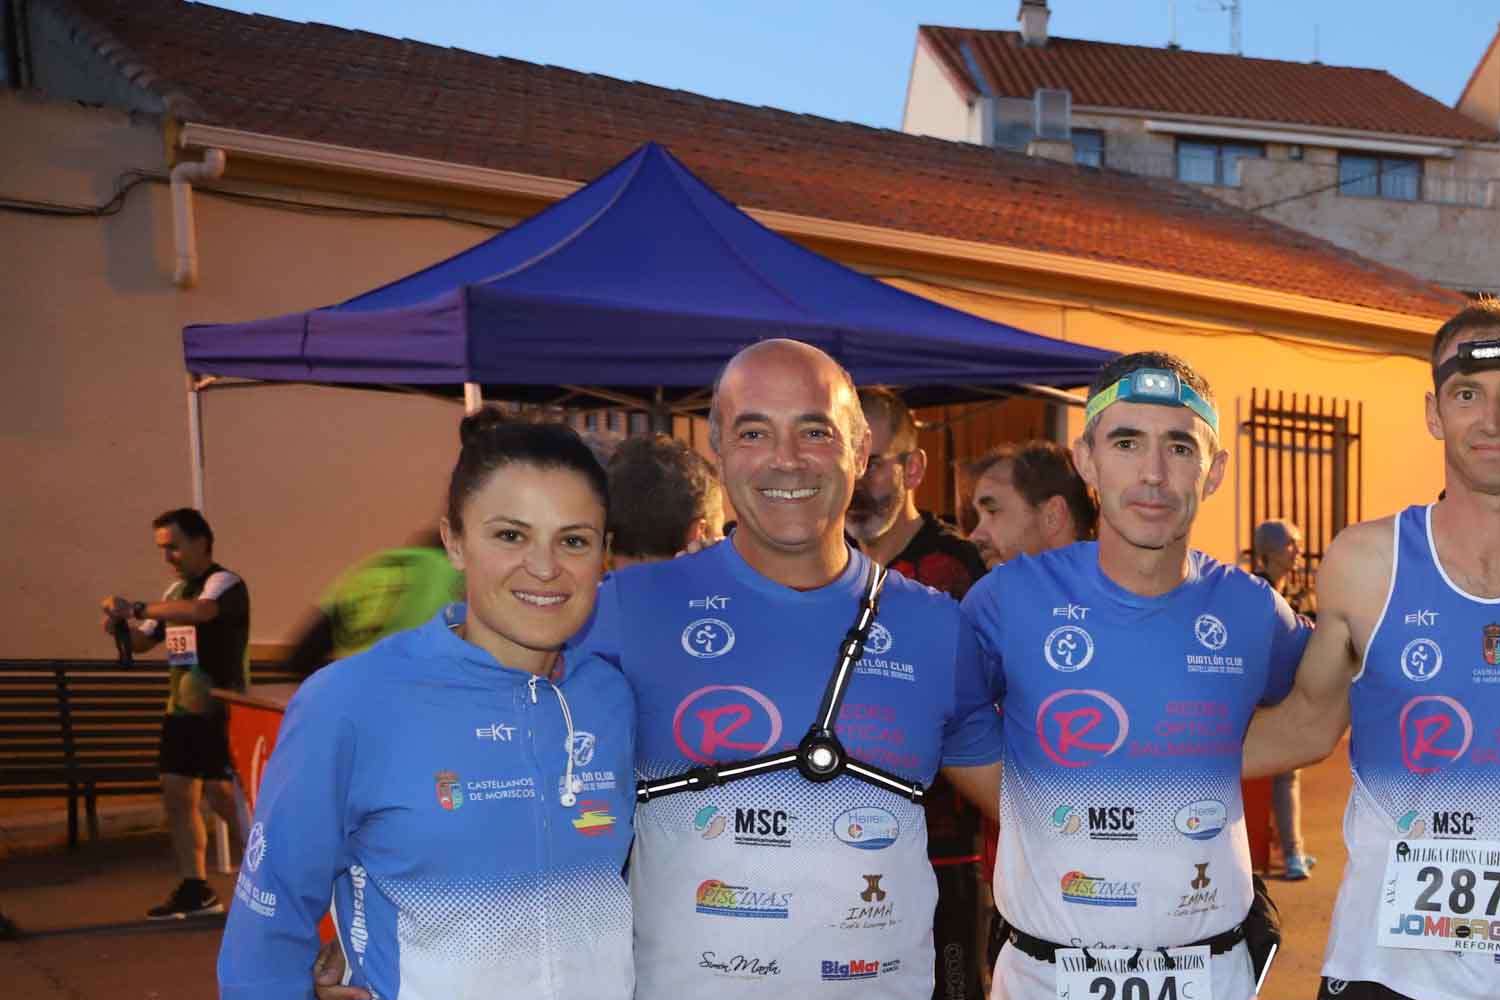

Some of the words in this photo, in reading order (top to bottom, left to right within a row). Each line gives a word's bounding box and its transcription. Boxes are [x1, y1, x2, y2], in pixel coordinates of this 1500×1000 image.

[467, 777, 535, 790] CASTELLANOS
[470, 793, 483, 801] DE
[485, 790, 536, 800] MORISCOS
[735, 807, 788, 836] MSC
[1088, 807, 1135, 831] MSC
[1433, 812, 1475, 835] MSC
[1445, 850, 1477, 865] CROSS
[1064, 878, 1140, 897] PISCINAS
[702, 887, 792, 908] PISCINAS
[821, 960, 879, 977] BigMat
[1113, 957, 1145, 974] CRS
